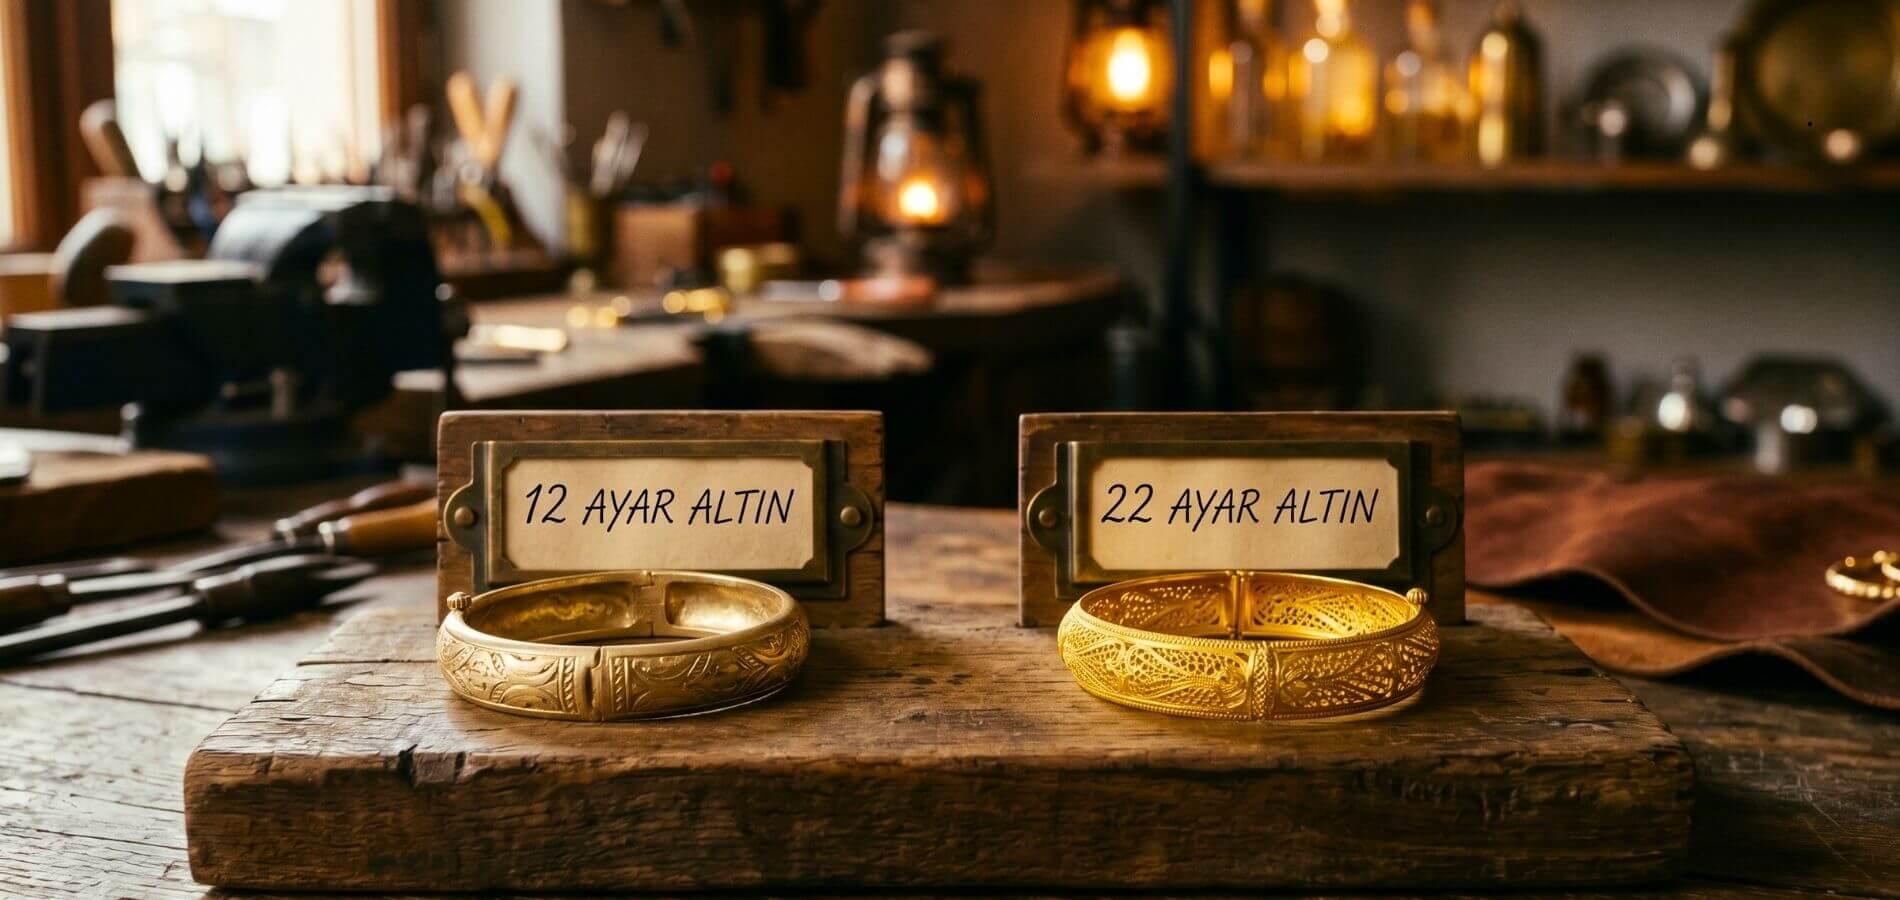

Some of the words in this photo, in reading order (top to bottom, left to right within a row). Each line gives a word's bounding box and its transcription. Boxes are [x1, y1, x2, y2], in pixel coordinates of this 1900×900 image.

[525, 483, 567, 524] 12
[582, 488, 675, 532] AYAR
[687, 488, 795, 525] ALTIN
[1101, 483, 1154, 523] 22
[1168, 488, 1260, 532] AYAR
[1273, 487, 1380, 524] ALTIN
